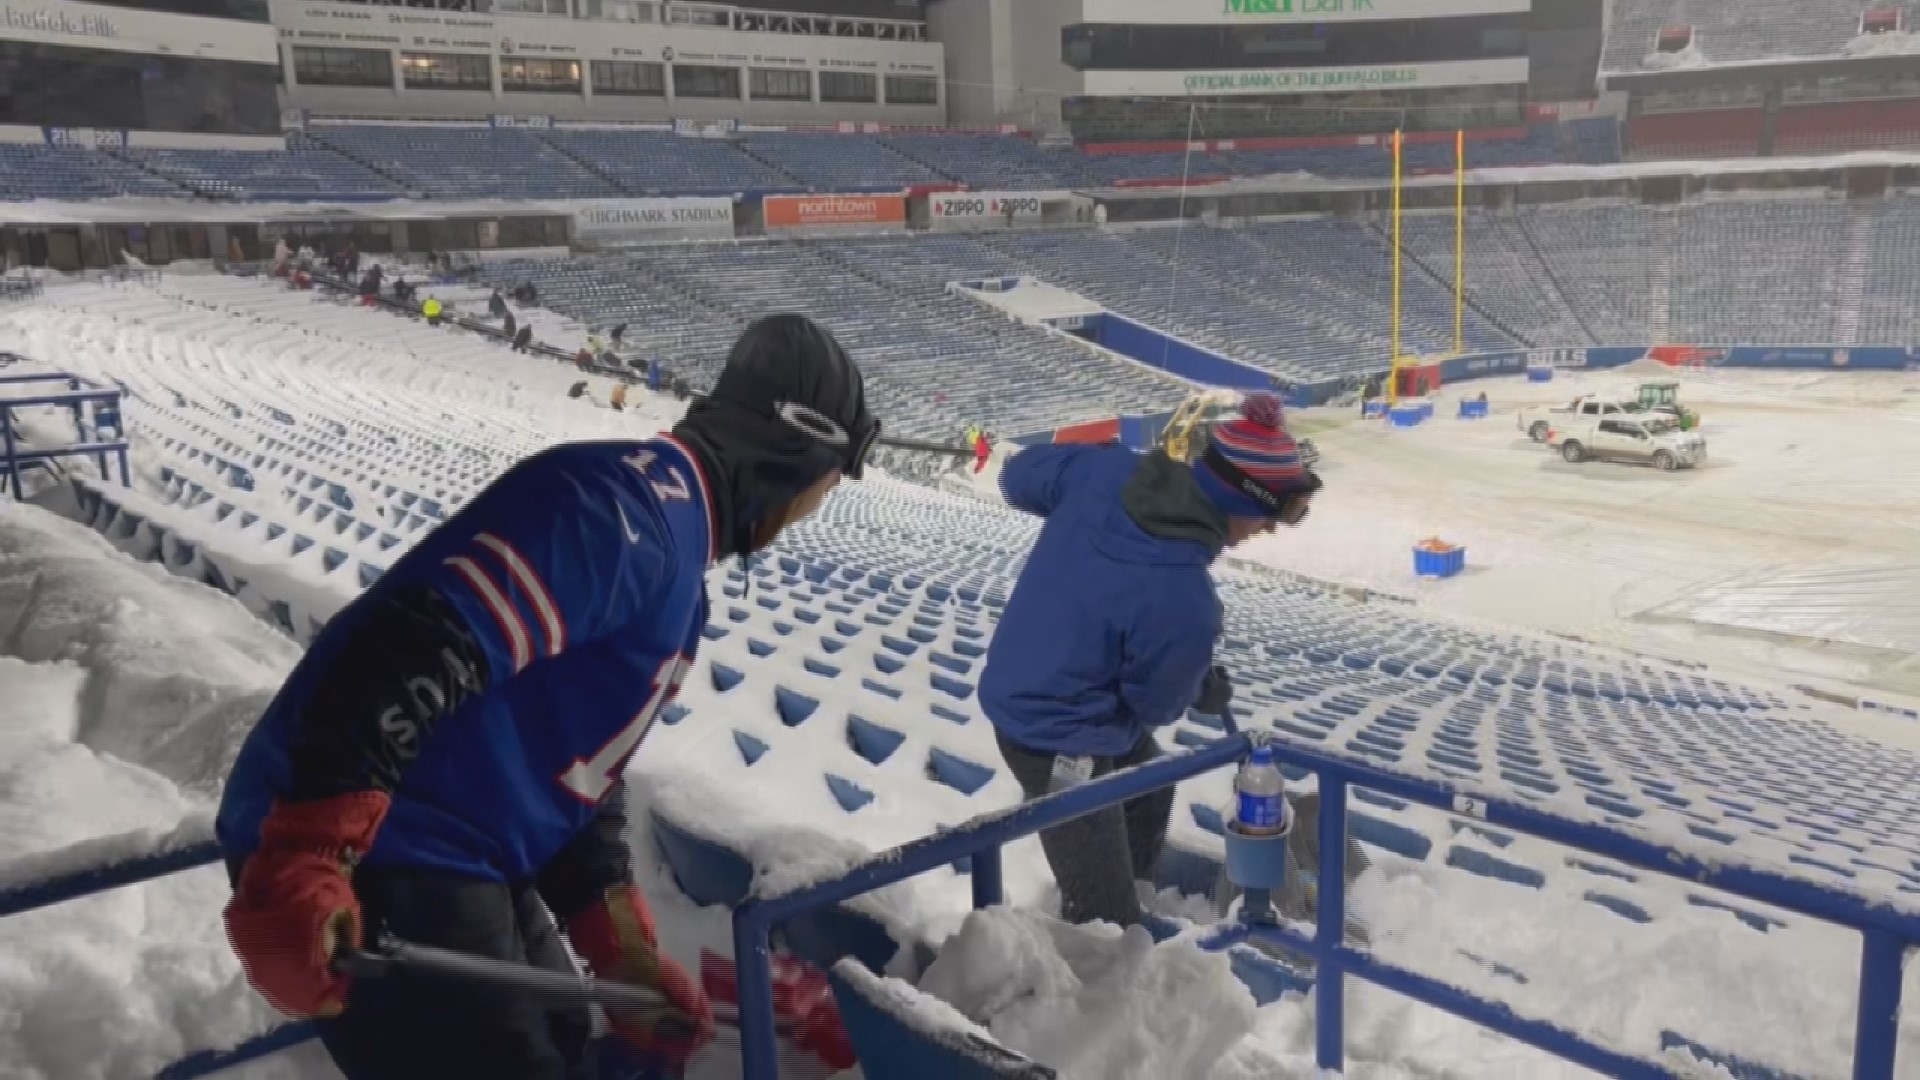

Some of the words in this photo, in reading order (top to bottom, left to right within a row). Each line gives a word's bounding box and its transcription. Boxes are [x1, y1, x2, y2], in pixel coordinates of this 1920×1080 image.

[588, 208, 667, 223] HIGHMARK
[671, 208, 729, 222] STADIUM
[944, 199, 985, 216] ZIPPO
